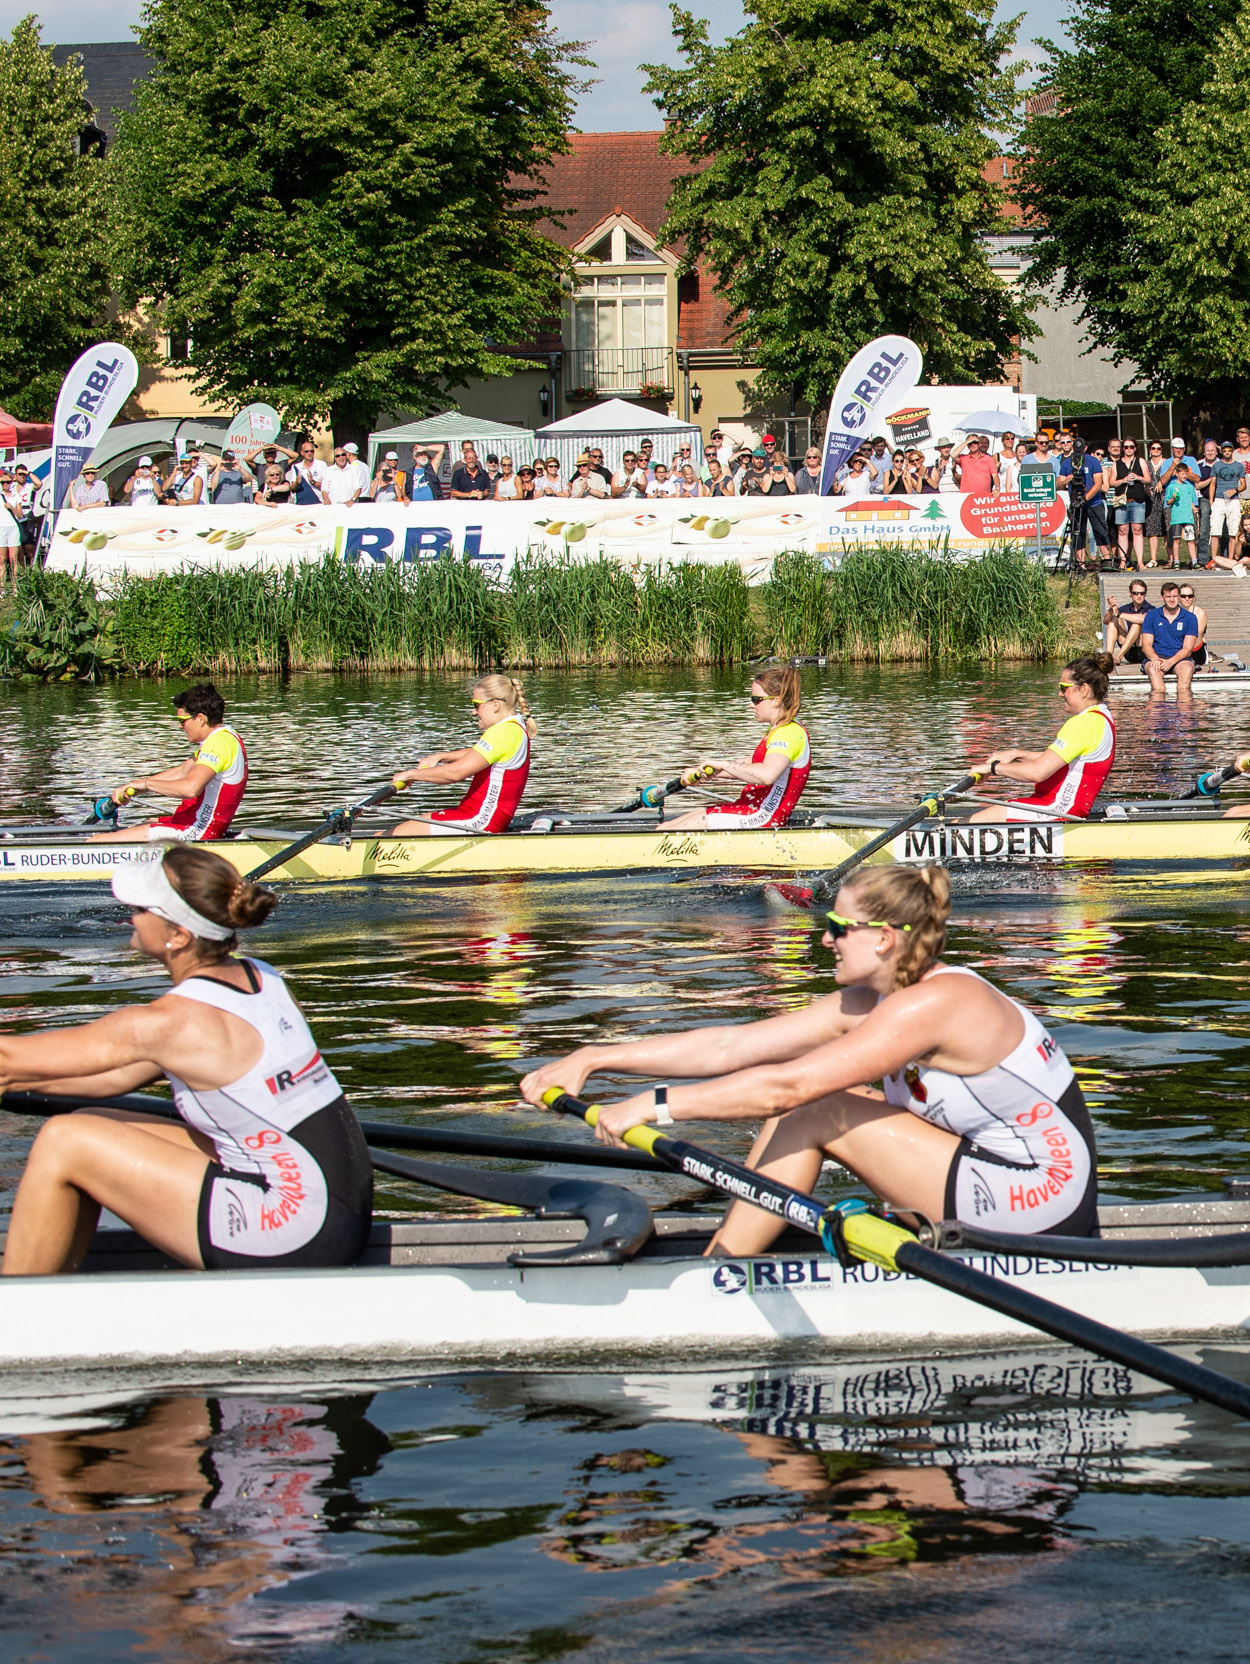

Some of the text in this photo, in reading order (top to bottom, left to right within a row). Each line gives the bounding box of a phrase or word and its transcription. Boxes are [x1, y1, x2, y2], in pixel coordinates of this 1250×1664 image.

[75, 358, 120, 413] RBL
[94, 362, 125, 415] RUDER-BUNDESLIGA
[853, 351, 905, 404] RBL
[870, 355, 909, 407] RUDER-BUNDESLIGA
[885, 408, 931, 425] BÖCKMANN
[230, 434, 248, 445] 100
[895, 429, 930, 443] HAVELLAND
[58, 447, 78, 455] STARK.
[58, 454, 84, 462] SCHNELL.
[973, 494, 1019, 505] Wir suc
[828, 524, 951, 536] Das Haus GmbH
[980, 516, 1000, 525] für
[343, 525, 506, 564] RBL
[364, 840, 413, 863] Melitta
[652, 834, 700, 857] Melitta
[904, 826, 1054, 857] MINDEN
[682, 1155, 783, 1214] STARK. SCHNELL. GUT.
[753, 1259, 831, 1286] RBL
[755, 1283, 831, 1293] RUDER-BUNDESLIGA
